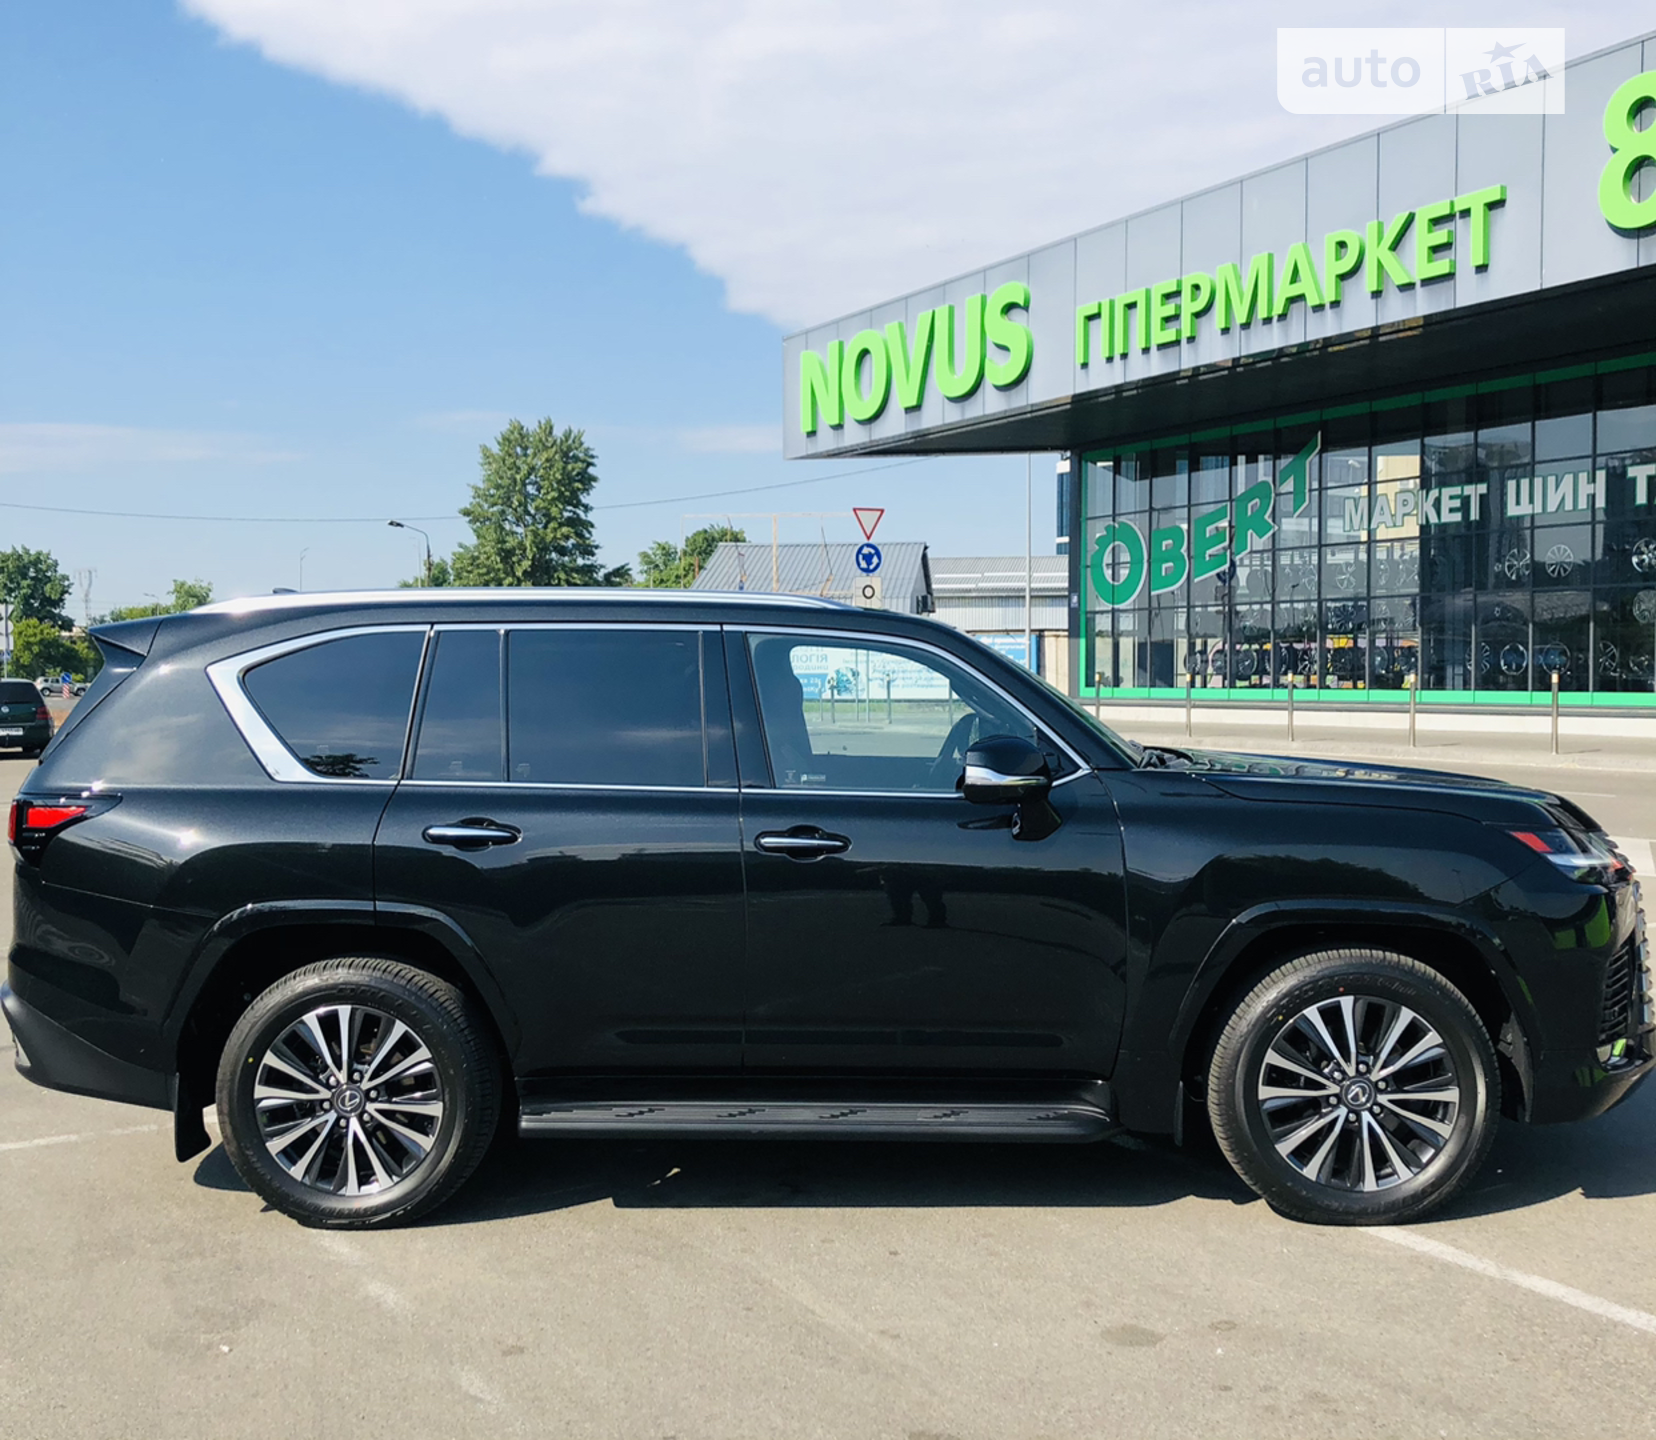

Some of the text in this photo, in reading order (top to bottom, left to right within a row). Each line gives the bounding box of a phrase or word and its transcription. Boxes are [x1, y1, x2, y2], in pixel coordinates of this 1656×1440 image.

[1076, 184, 1507, 366] ГІПЕРМАРКЕТ
[800, 281, 1034, 436] NOVUS
[1343, 463, 1656, 532] МАРКЕТ ШИН Т
